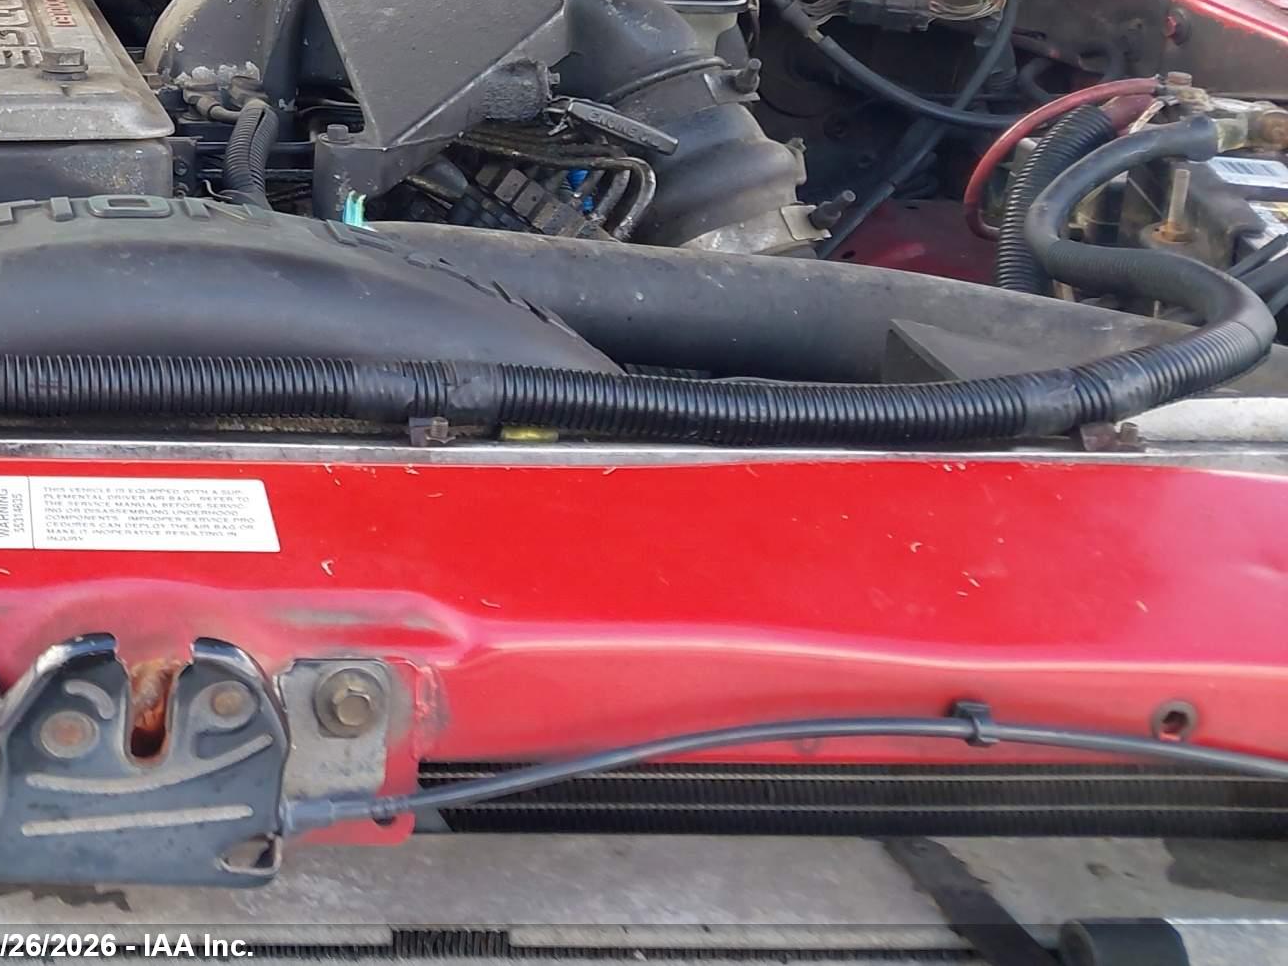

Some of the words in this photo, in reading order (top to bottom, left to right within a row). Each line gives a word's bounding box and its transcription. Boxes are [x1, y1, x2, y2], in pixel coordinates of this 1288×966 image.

[43, 486, 66, 494] THIS
[43, 493, 103, 502] PLEMENTAL
[107, 494, 146, 503] DRIVER
[44, 500, 62, 508] THE
[67, 500, 110, 509] SERVICE
[115, 501, 157, 509] MANUAL
[84, 507, 168, 517] DISASSEMBLING
[172, 509, 238, 518] UNDERHOOD
[127, 515, 182, 524] IMPROPER
[186, 516, 229, 524] SERVICE
[99, 521, 121, 530] CAN
[46, 527, 75, 536] MAKE
